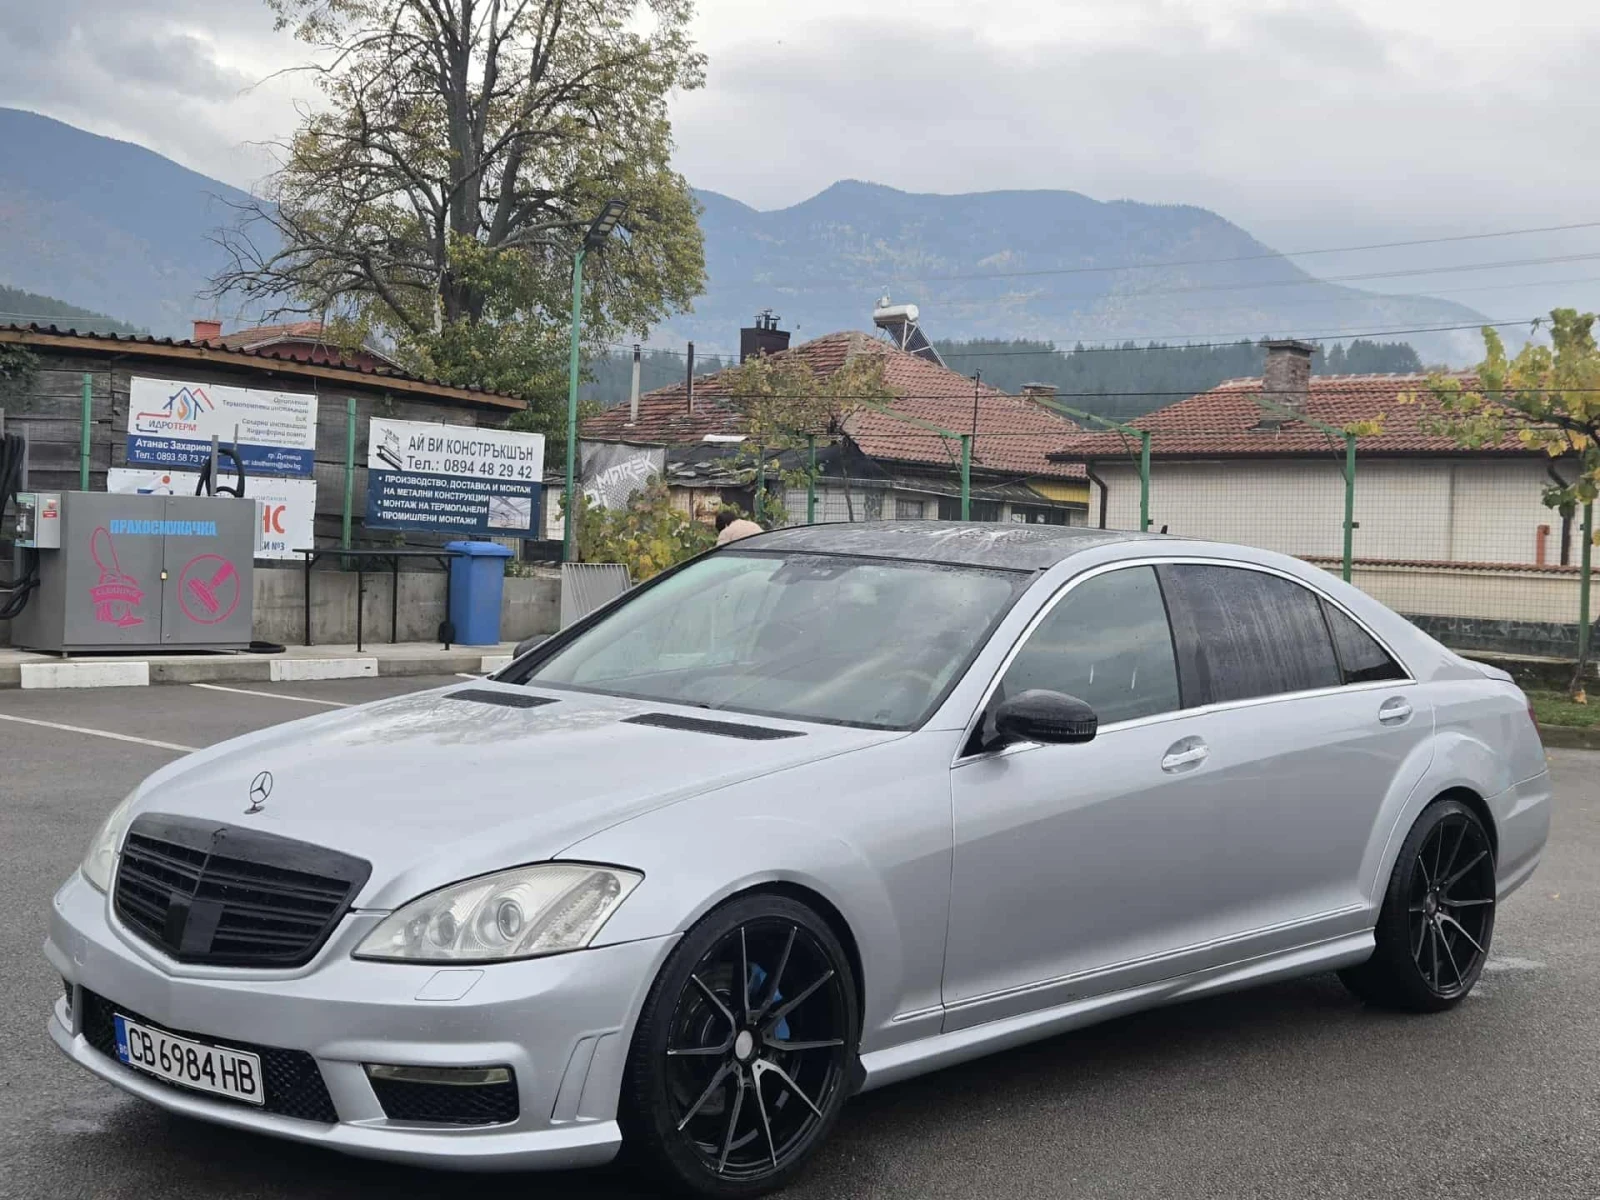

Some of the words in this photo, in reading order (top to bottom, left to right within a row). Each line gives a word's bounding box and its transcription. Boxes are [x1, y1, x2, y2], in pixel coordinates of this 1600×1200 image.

[148, 420, 197, 432] ИДРОТЕРМ
[135, 438, 168, 449] Атанас
[170, 440, 212, 453] Захариев
[408, 433, 425, 451] АЙ
[427, 438, 444, 452] ВИ
[446, 438, 533, 461] КОНСТРЪКШЪН
[134, 450, 154, 460] Тел.:
[156, 451, 176, 461] 0893
[177, 453, 187, 462] 58
[189, 454, 199, 463] 73
[406, 455, 439, 471] Тел.:
[443, 458, 474, 474] 0894
[478, 461, 494, 475] 48
[498, 463, 514, 477] 29
[517, 465, 533, 479] 42
[384, 475, 449, 488] ПРОИЗВОДСТВО,
[450, 480, 491, 492] ДОСТАВКА
[499, 484, 532, 494] МОНТАЖ
[396, 488, 433, 498] МЕТАЛНИ
[434, 491, 489, 502] КОНСТРУКЦИИ
[383, 499, 417, 509] МОНТАЖ
[418, 501, 430, 510] НА
[430, 502, 488, 514] ТЕРМОПАНЕЛИ
[382, 511, 437, 522] ПРОМИШЛЕНИ
[438, 514, 478, 525] МОНТАЖИ
[110, 519, 218, 536] ПРАХОСМУКАЧКА
